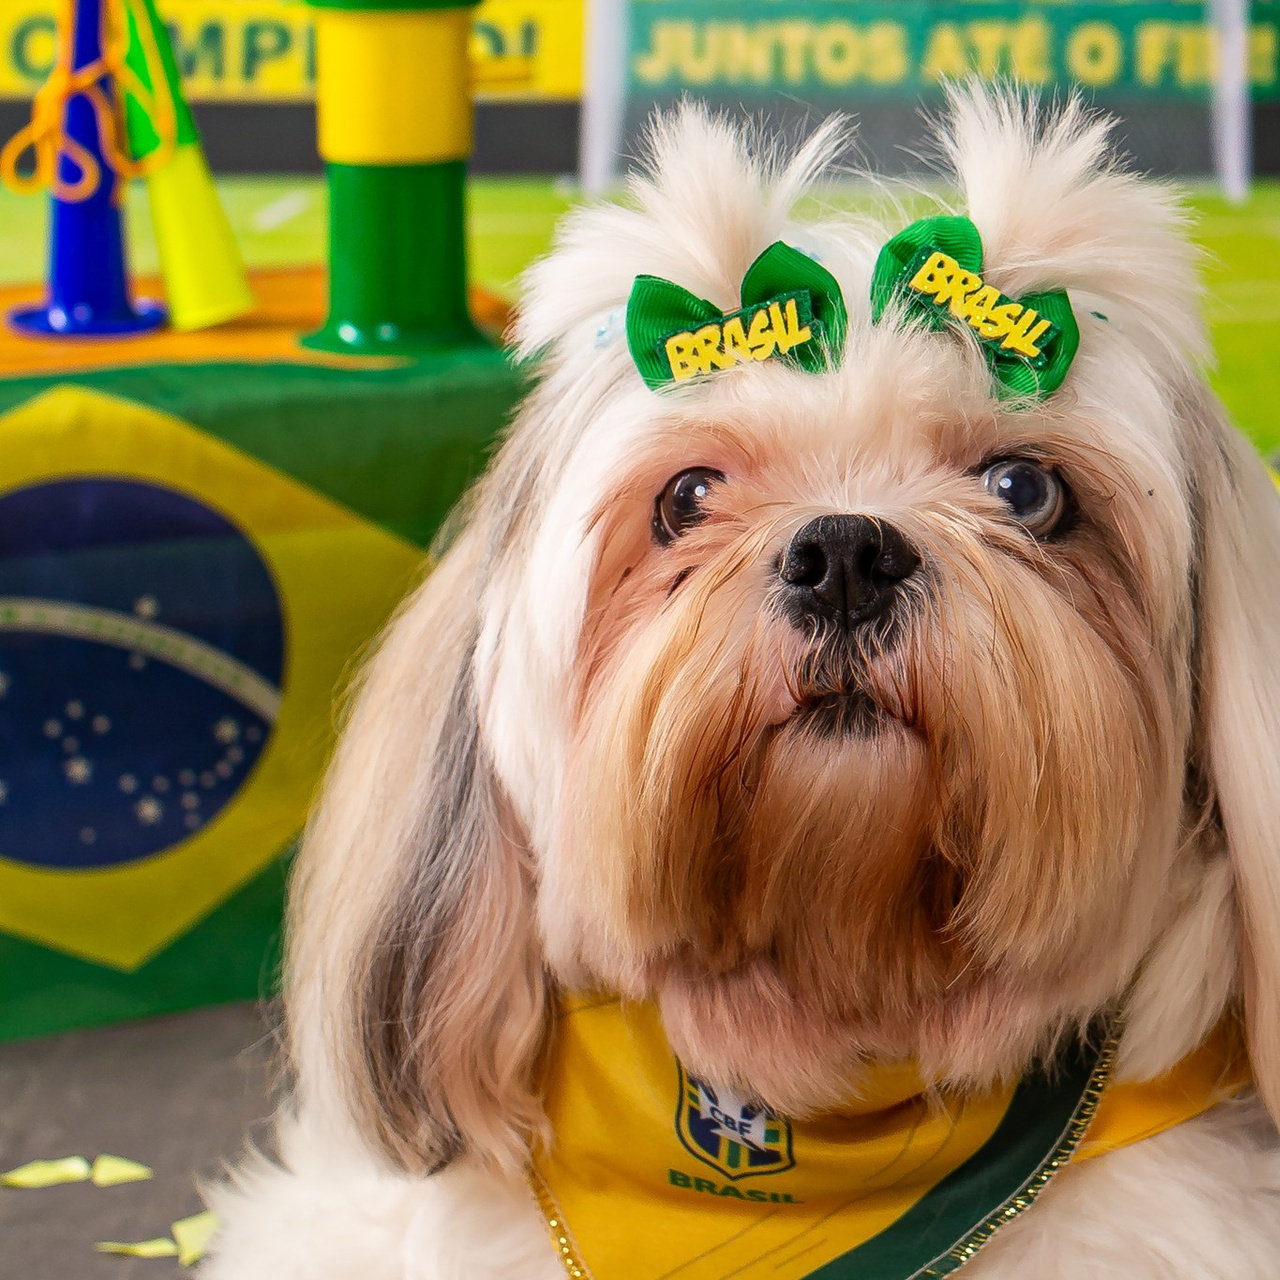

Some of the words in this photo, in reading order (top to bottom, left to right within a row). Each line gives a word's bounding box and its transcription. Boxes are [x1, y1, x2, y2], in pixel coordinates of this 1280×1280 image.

[634, 19, 909, 86] JUNTOS
[921, 14, 1056, 83] ATÉ
[1065, 22, 1123, 85] O
[908, 250, 1053, 358] BRASIL
[664, 298, 813, 383] BRASIL
[709, 1105, 752, 1136] CBF
[668, 1168, 804, 1204] BRASIL
